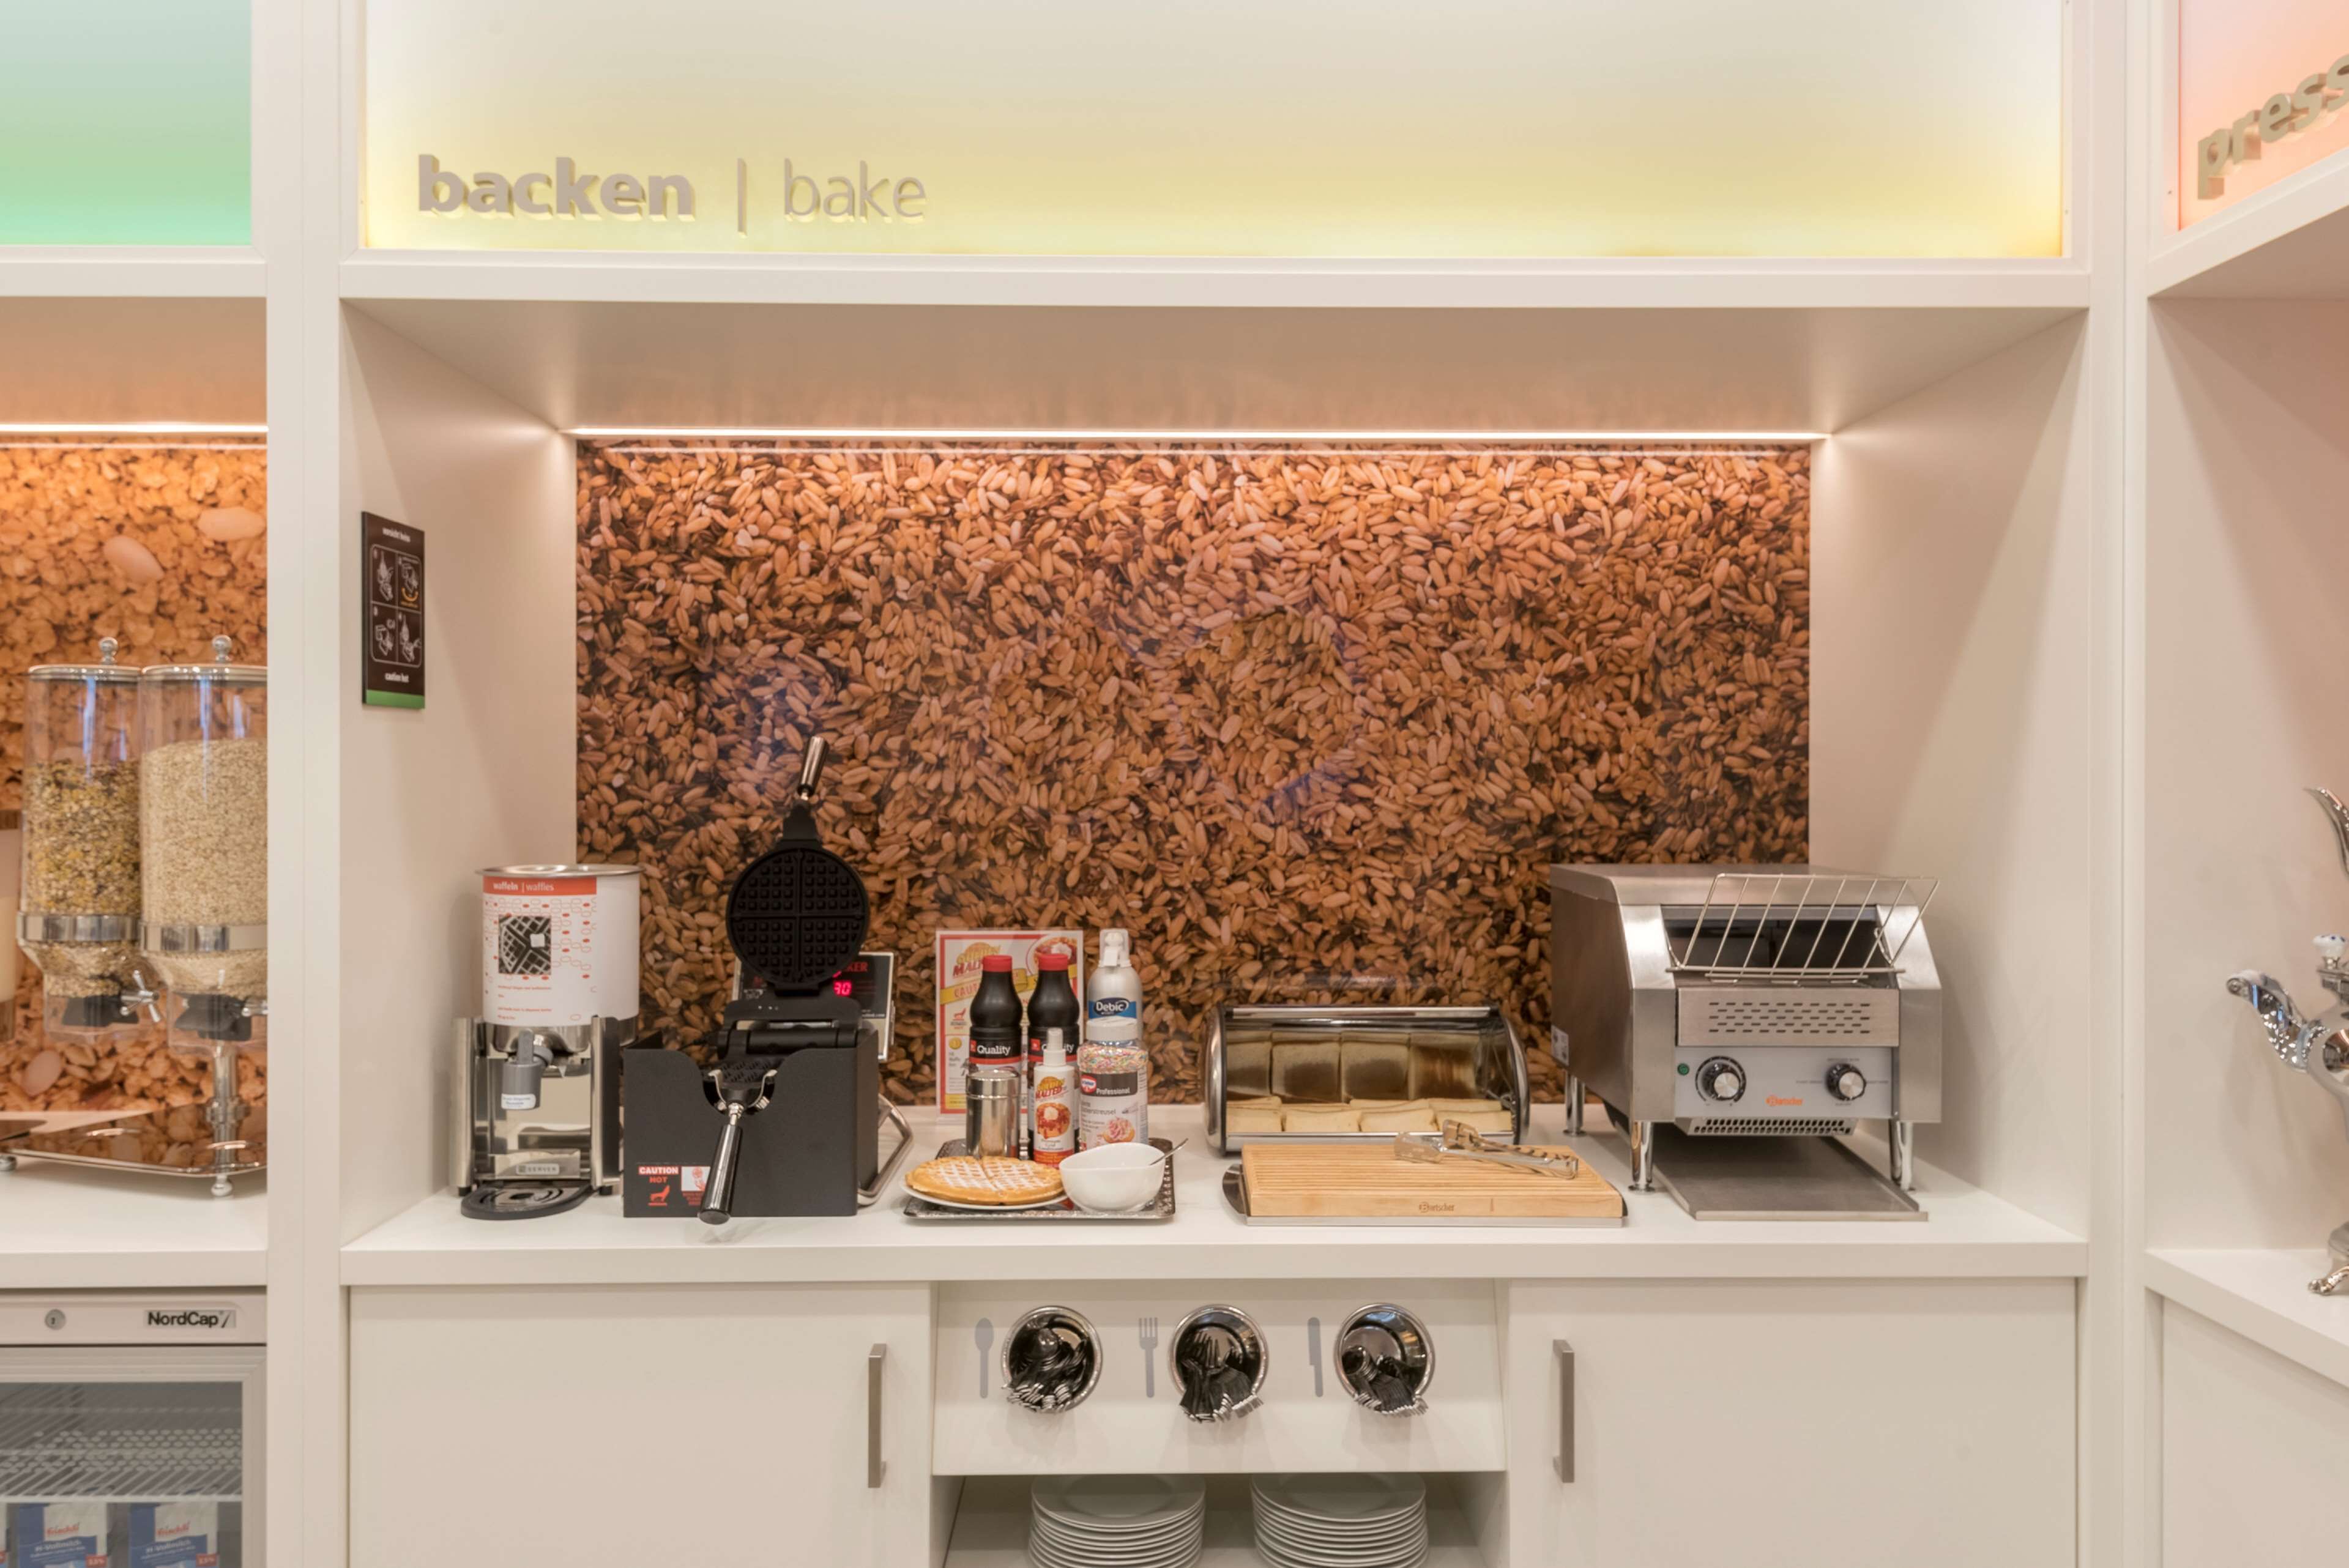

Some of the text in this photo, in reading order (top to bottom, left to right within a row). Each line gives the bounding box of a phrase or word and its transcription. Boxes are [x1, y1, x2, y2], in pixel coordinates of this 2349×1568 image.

[418, 154, 695, 221] backen
[784, 158, 927, 221] bake
[1096, 1001, 1126, 1012] Debic
[977, 1044, 1011, 1056] Quality
[639, 1166, 679, 1175] CAUTION
[148, 1311, 218, 1328] NordCap
